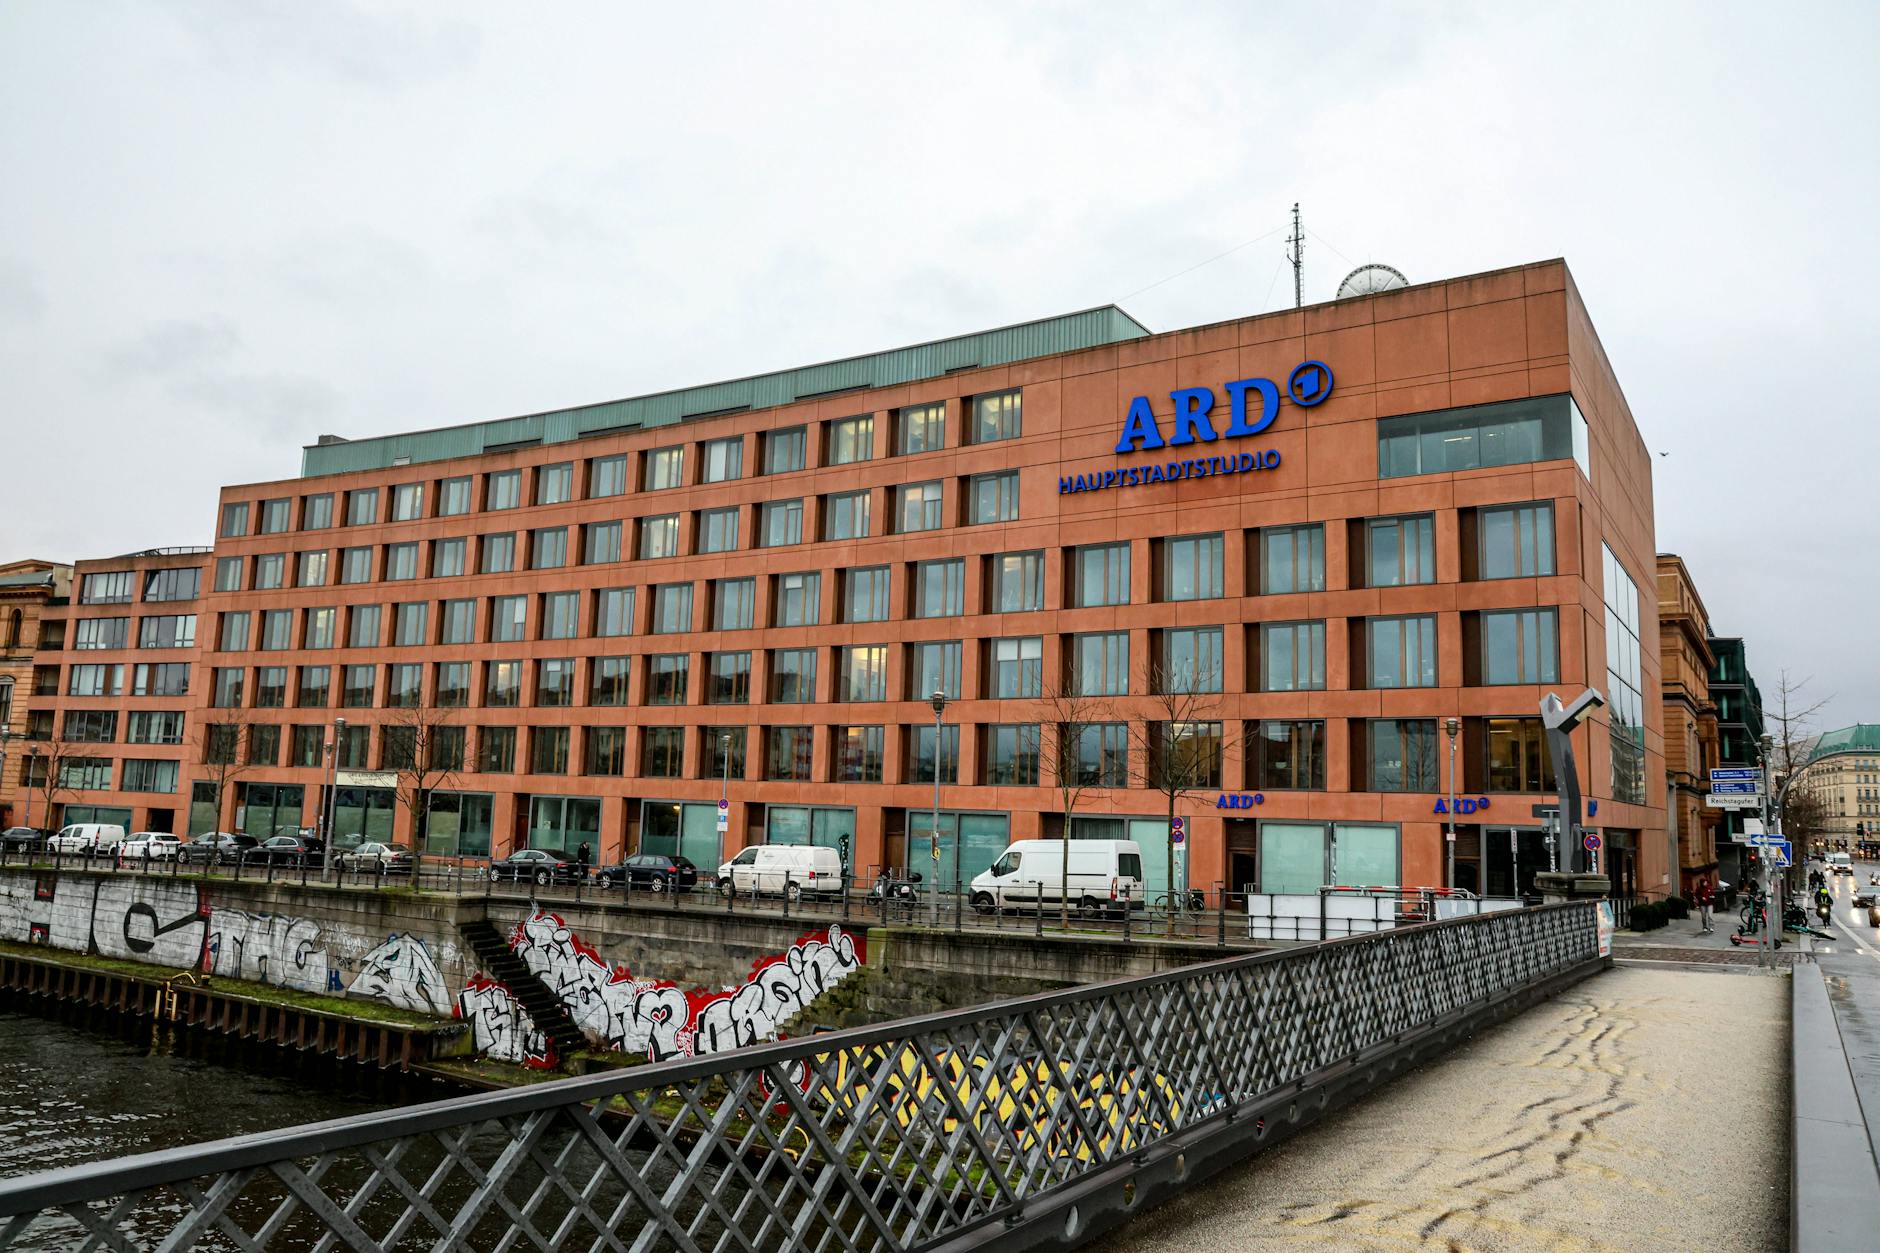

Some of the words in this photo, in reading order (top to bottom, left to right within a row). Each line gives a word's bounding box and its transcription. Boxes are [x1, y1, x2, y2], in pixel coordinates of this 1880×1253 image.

[1115, 378, 1280, 453] ARD
[1059, 450, 1281, 494] HAUPTSTADTSTUDIO
[1216, 794, 1254, 809] ARD
[1433, 798, 1477, 814] ARD
